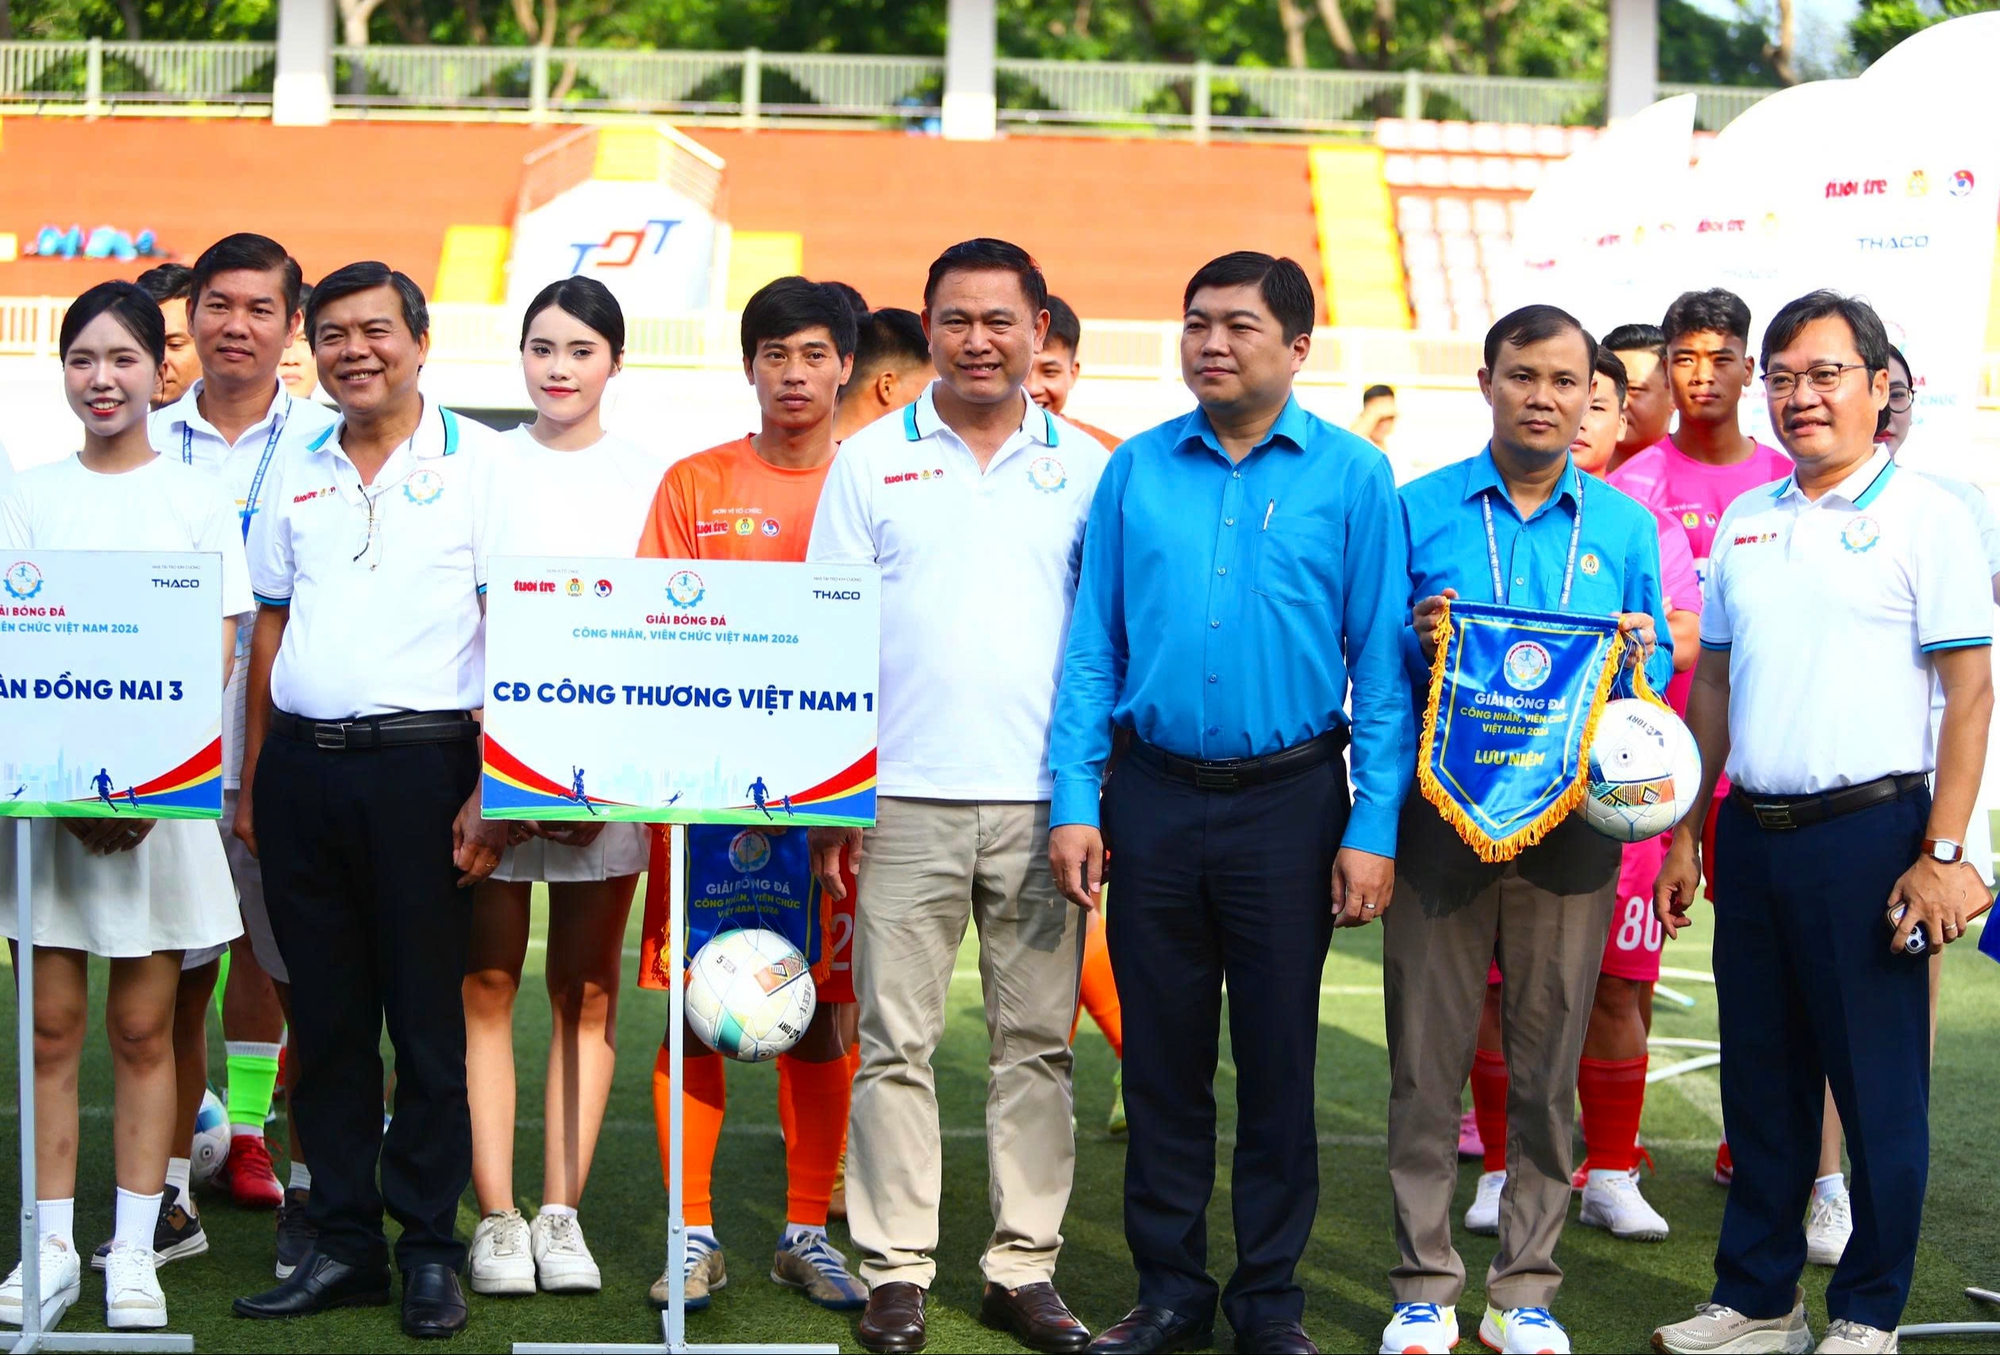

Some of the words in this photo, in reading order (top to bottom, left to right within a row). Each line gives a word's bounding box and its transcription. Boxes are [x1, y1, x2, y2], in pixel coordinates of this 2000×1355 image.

[1857, 235, 1929, 250] THACO
[151, 578, 200, 588] THACO
[813, 590, 861, 600] THACO
[12, 605, 46, 616] BÓNG
[49, 605, 66, 617] ĐÁ
[646, 612, 670, 625] GIẢI
[673, 613, 707, 626] BÓNG
[710, 614, 727, 626] ĐÁ
[19, 621, 51, 632] CHỨC
[55, 621, 80, 635] VIỆT
[82, 623, 108, 633] NAM
[111, 624, 139, 633] 2026
[572, 626, 608, 638] CÔNG
[611, 627, 646, 640] NHÂN,
[650, 628, 676, 640] VIÊN
[679, 628, 712, 641] CHỨC
[715, 630, 740, 644] VIỆT
[743, 633, 769, 643] NAM
[771, 634, 799, 644] 2026
[33, 671, 113, 700] ĐỒNG
[119, 680, 163, 700] NAI
[169, 681, 183, 701] 3
[493, 681, 530, 702] CĐ
[537, 678, 616, 704] CÔNG
[622, 684, 732, 708] THƯƠNG
[738, 684, 794, 715] VIỆT
[800, 689, 857, 712] NAM
[863, 692, 873, 712] 1
[1474, 691, 1504, 707] GIẢI
[1505, 694, 1545, 709] BÓNG
[1460, 706, 1491, 719] CÔNG
[1525, 712, 1546, 723] VIÊN
[1482, 723, 1502, 735] VIỆT
[1504, 726, 1526, 735] NAM
[1474, 749, 1506, 765] LƯU
[1508, 749, 1546, 771] NIỆM
[705, 880, 733, 894] GIẢI
[734, 876, 771, 890] BÓNG
[773, 881, 791, 895] ĐÁ
[694, 898, 724, 908] CÔNG
[775, 897, 801, 908] CHỨC
[1616, 896, 1661, 952] 80
